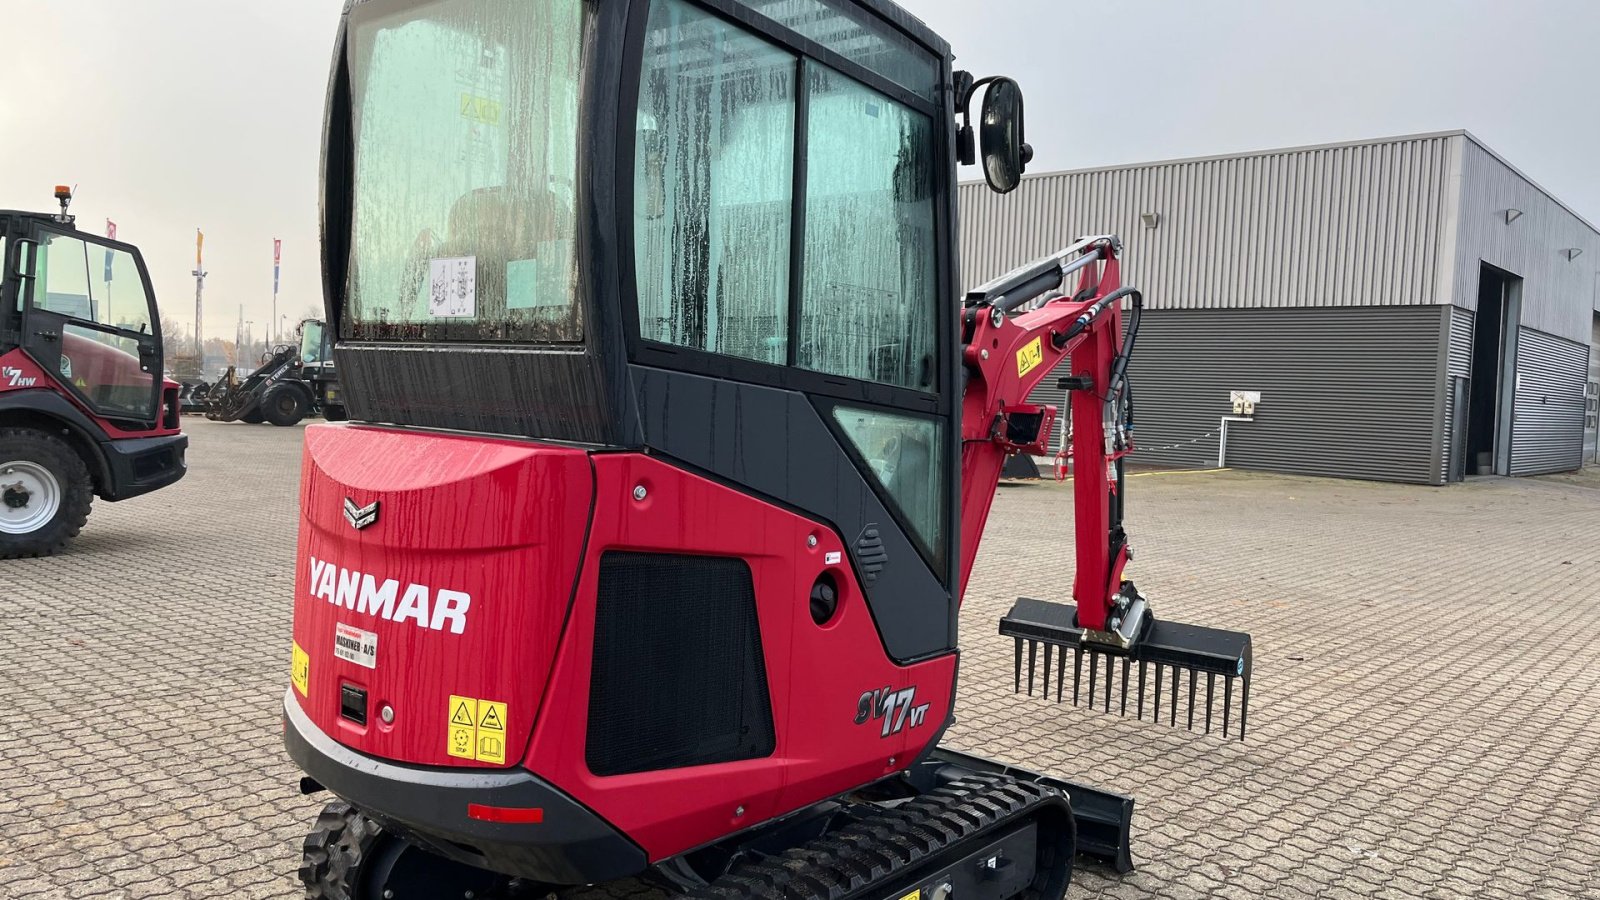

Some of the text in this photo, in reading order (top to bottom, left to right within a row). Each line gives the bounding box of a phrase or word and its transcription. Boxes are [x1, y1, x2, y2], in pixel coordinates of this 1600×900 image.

[271, 364, 290, 381] TEREX
[310, 556, 471, 635] YANMAR
[363, 643, 375, 656] A/S
